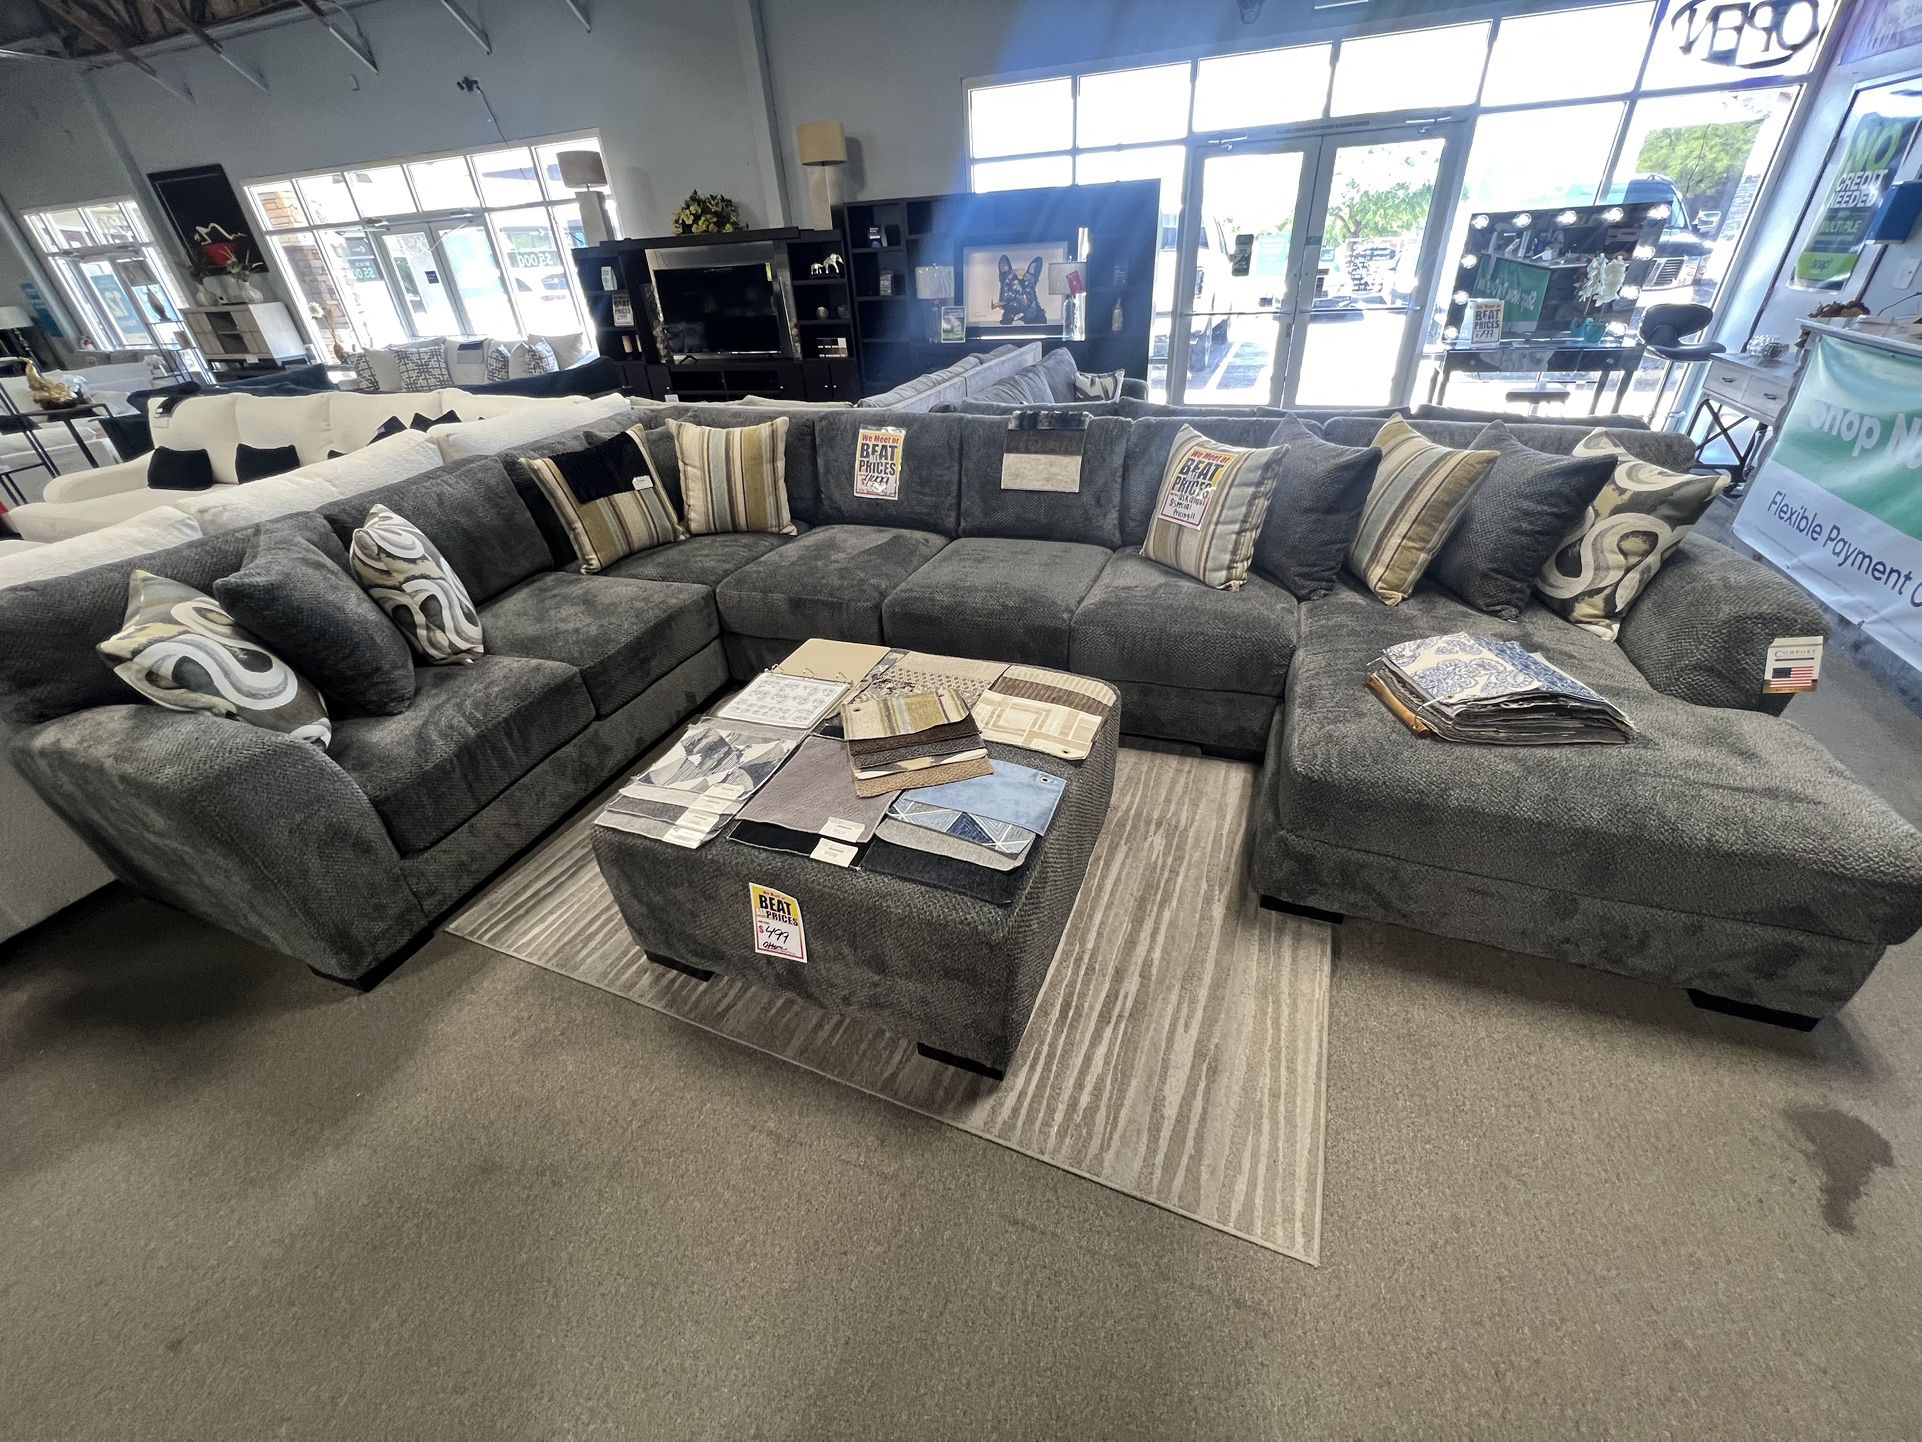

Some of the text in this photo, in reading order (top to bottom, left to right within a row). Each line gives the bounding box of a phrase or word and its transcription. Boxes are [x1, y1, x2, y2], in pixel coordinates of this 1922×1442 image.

[1836, 169, 1888, 192] CREDIT
[1475, 309, 1500, 320] BEAT
[1474, 320, 1500, 329] PRICES
[862, 434, 873, 442] We
[874, 435, 891, 444] Meet
[860, 443, 898, 461] BEAT
[1203, 453, 1221, 462] Meet
[859, 460, 896, 475] PRICES
[1179, 458, 1224, 481] BEAT
[1172, 476, 1212, 499] PRICES
[1767, 490, 1823, 542] Flexible
[1823, 524, 1913, 596] Payment
[758, 894, 792, 916] BEAT
[766, 910, 799, 927] PRICES
